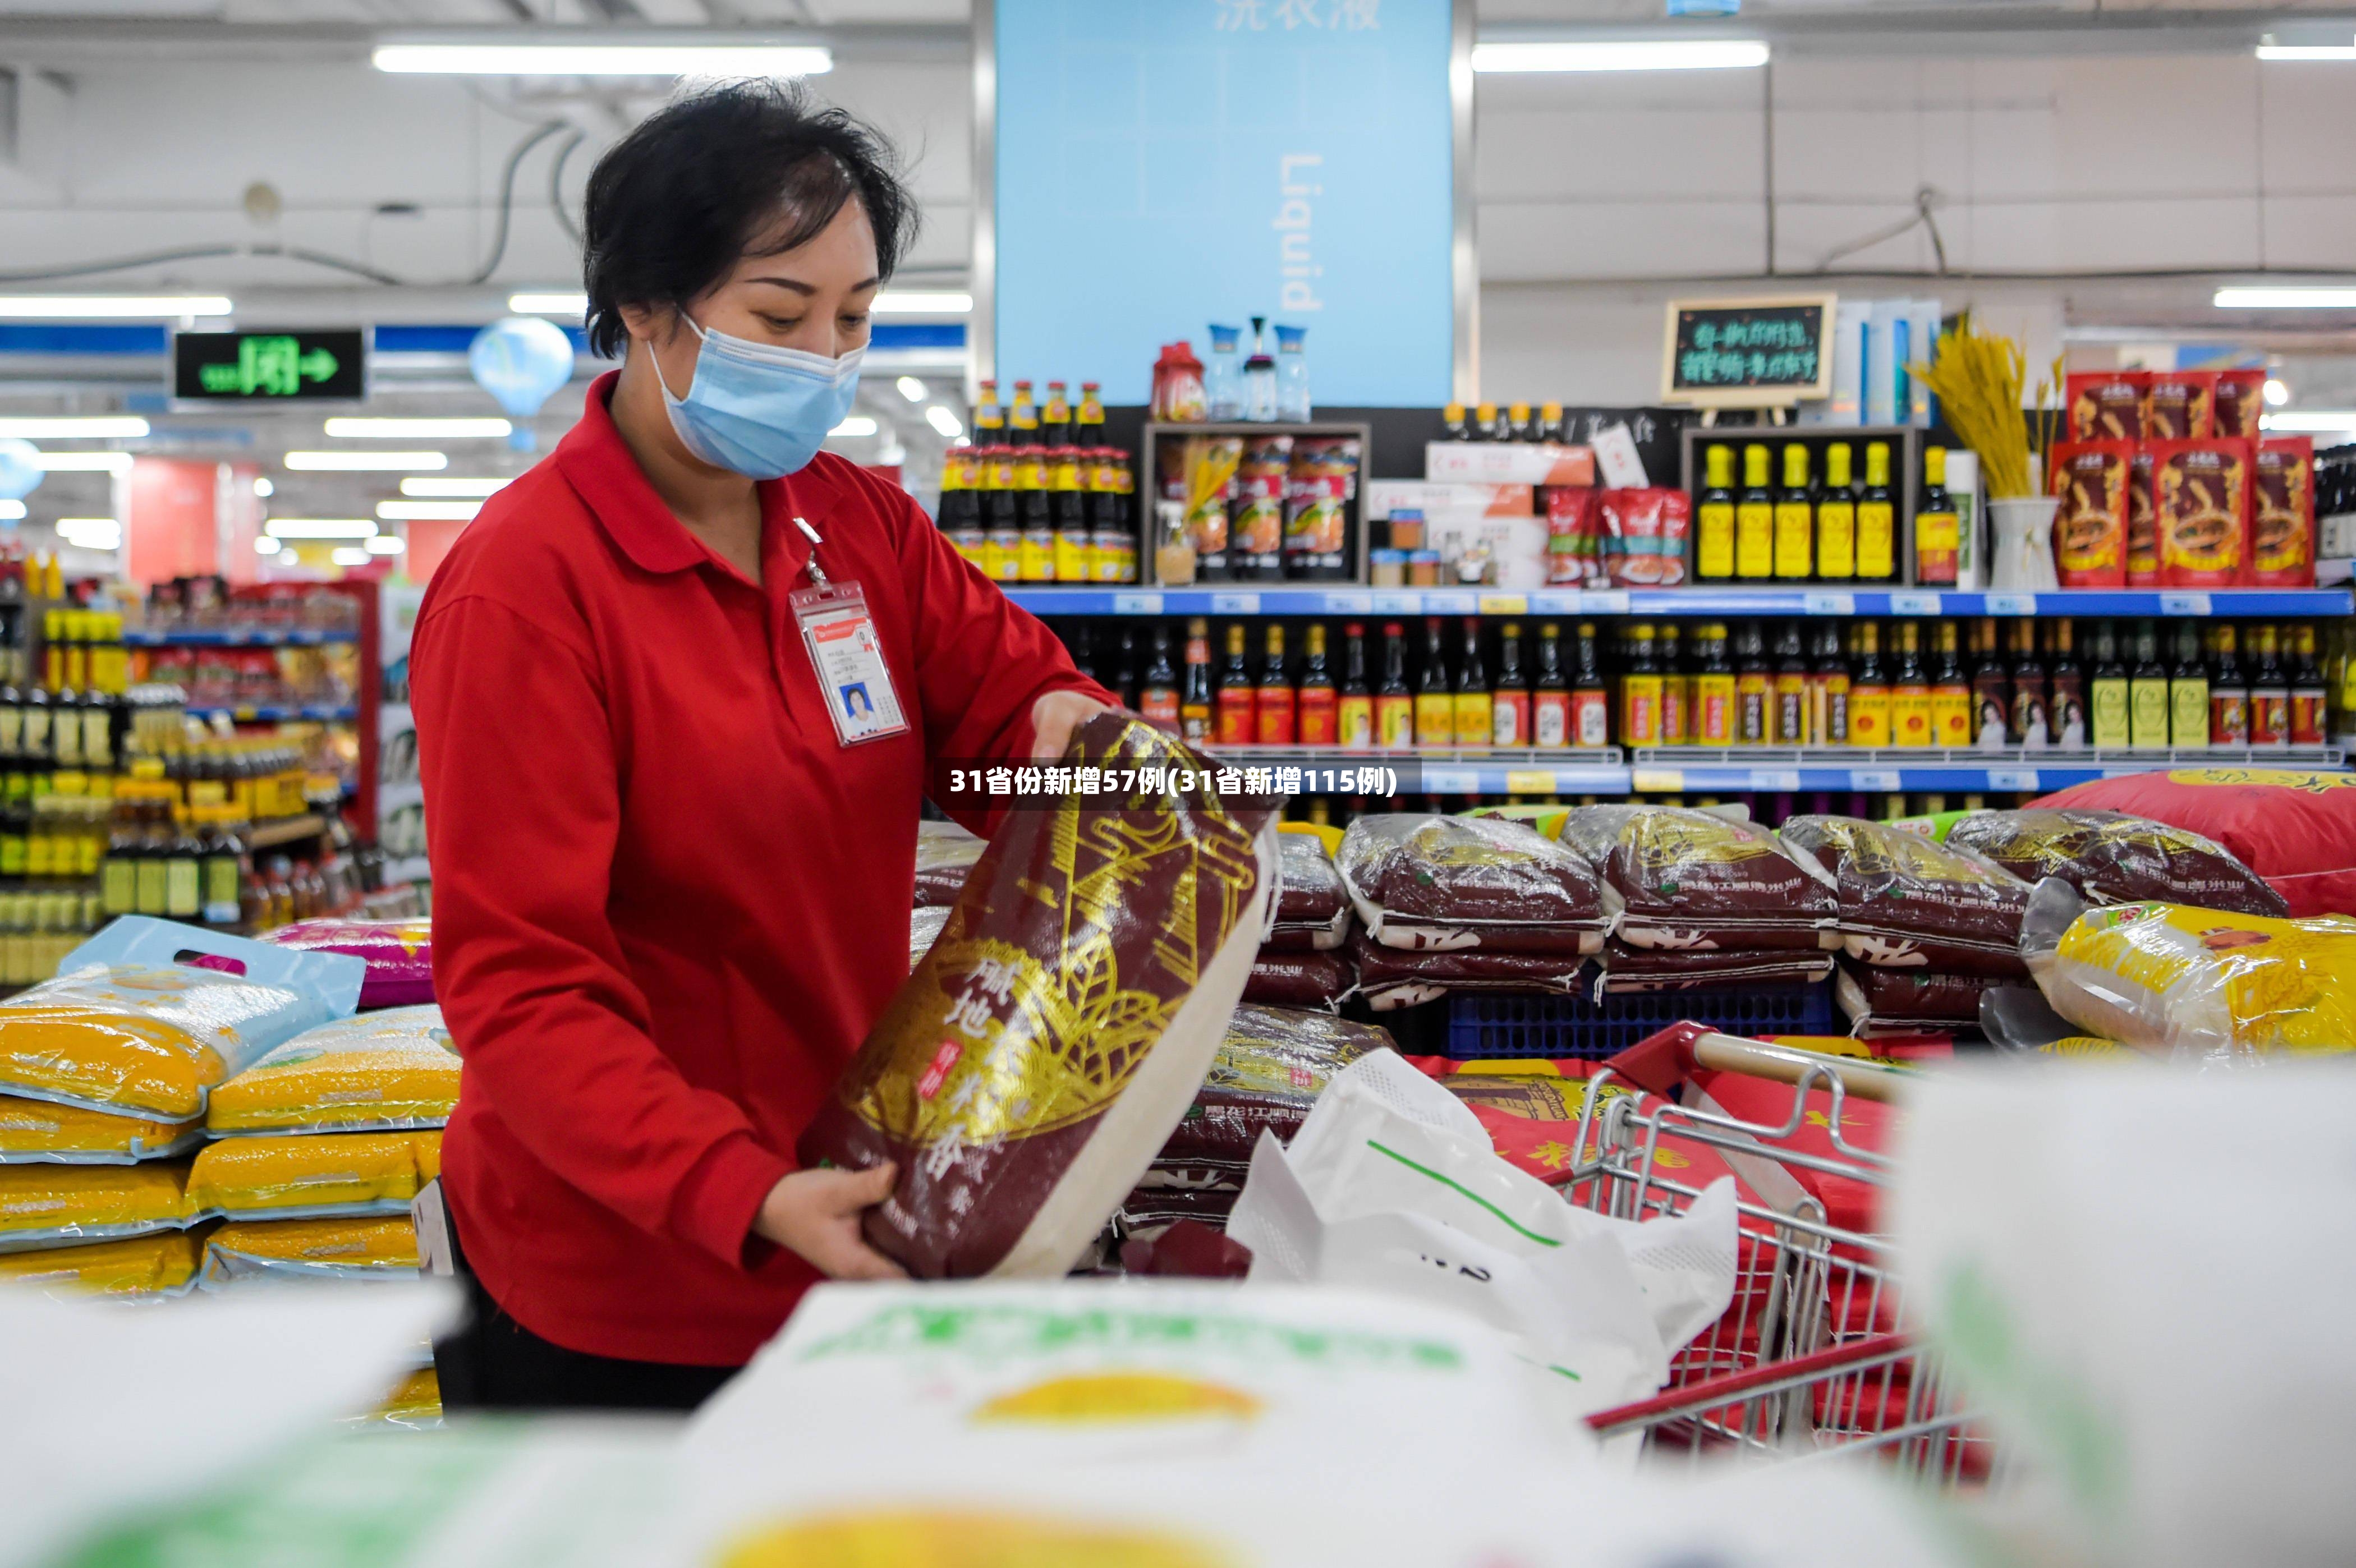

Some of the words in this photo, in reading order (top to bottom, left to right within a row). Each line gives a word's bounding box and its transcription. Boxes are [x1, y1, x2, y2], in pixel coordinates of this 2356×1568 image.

[1214, 0, 1381, 31] 洗衣液
[1273, 154, 1323, 311] Liquid
